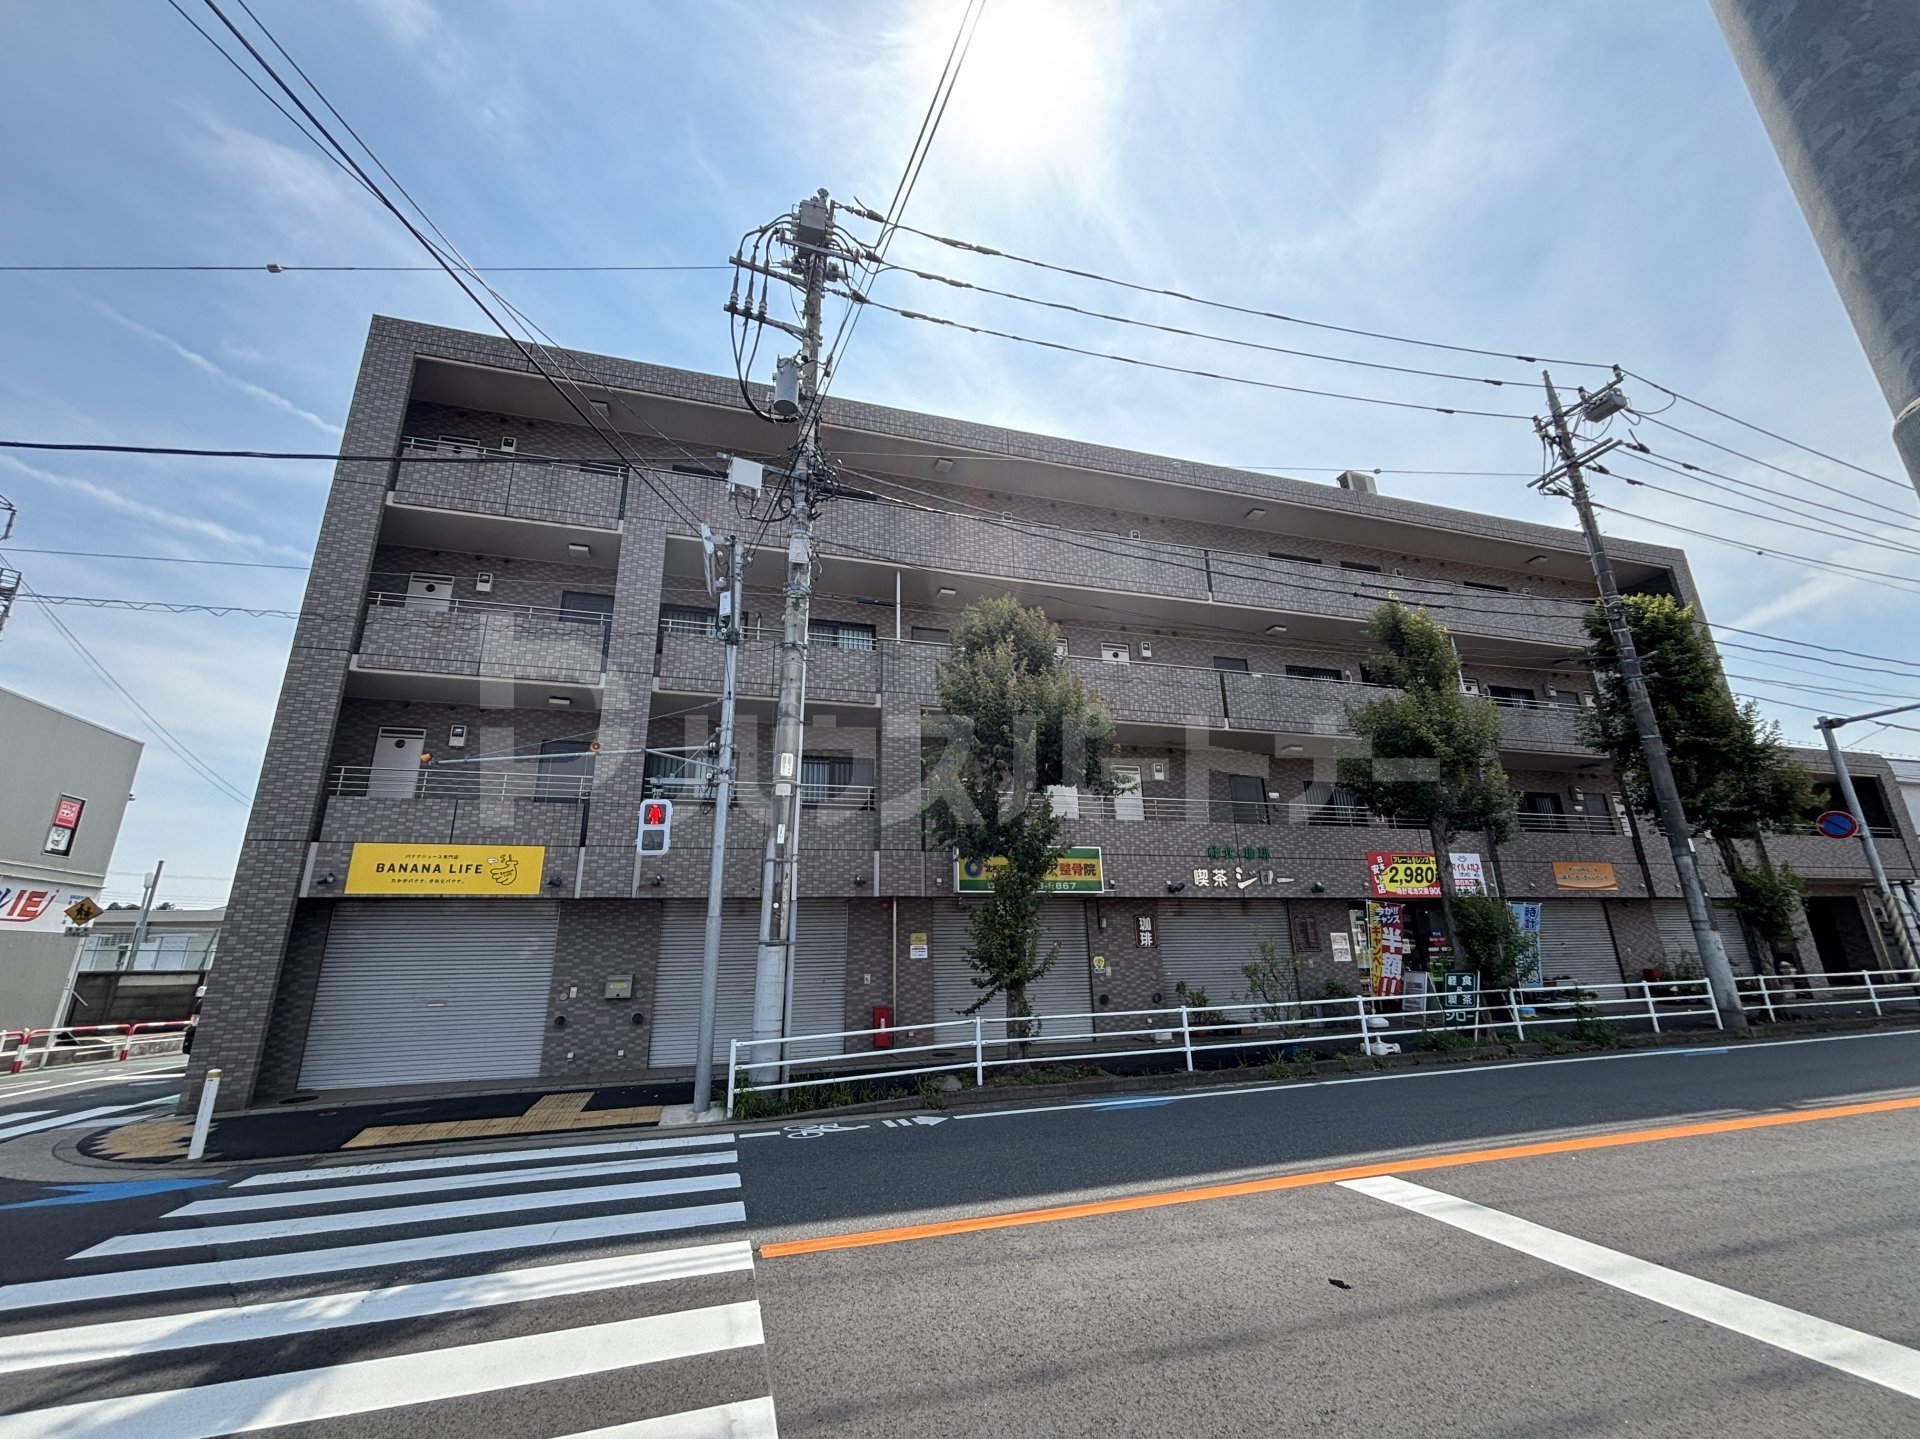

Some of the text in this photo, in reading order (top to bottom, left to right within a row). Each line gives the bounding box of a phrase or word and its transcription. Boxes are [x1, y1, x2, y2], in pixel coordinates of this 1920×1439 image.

[375, 863, 483, 874] BANANA LIFE
[1373, 915, 1401, 924] チャンス
[1138, 917, 1153, 947] 珈琲
[1447, 975, 1473, 986] 軽食
[1447, 994, 1473, 1005] 喫茶
